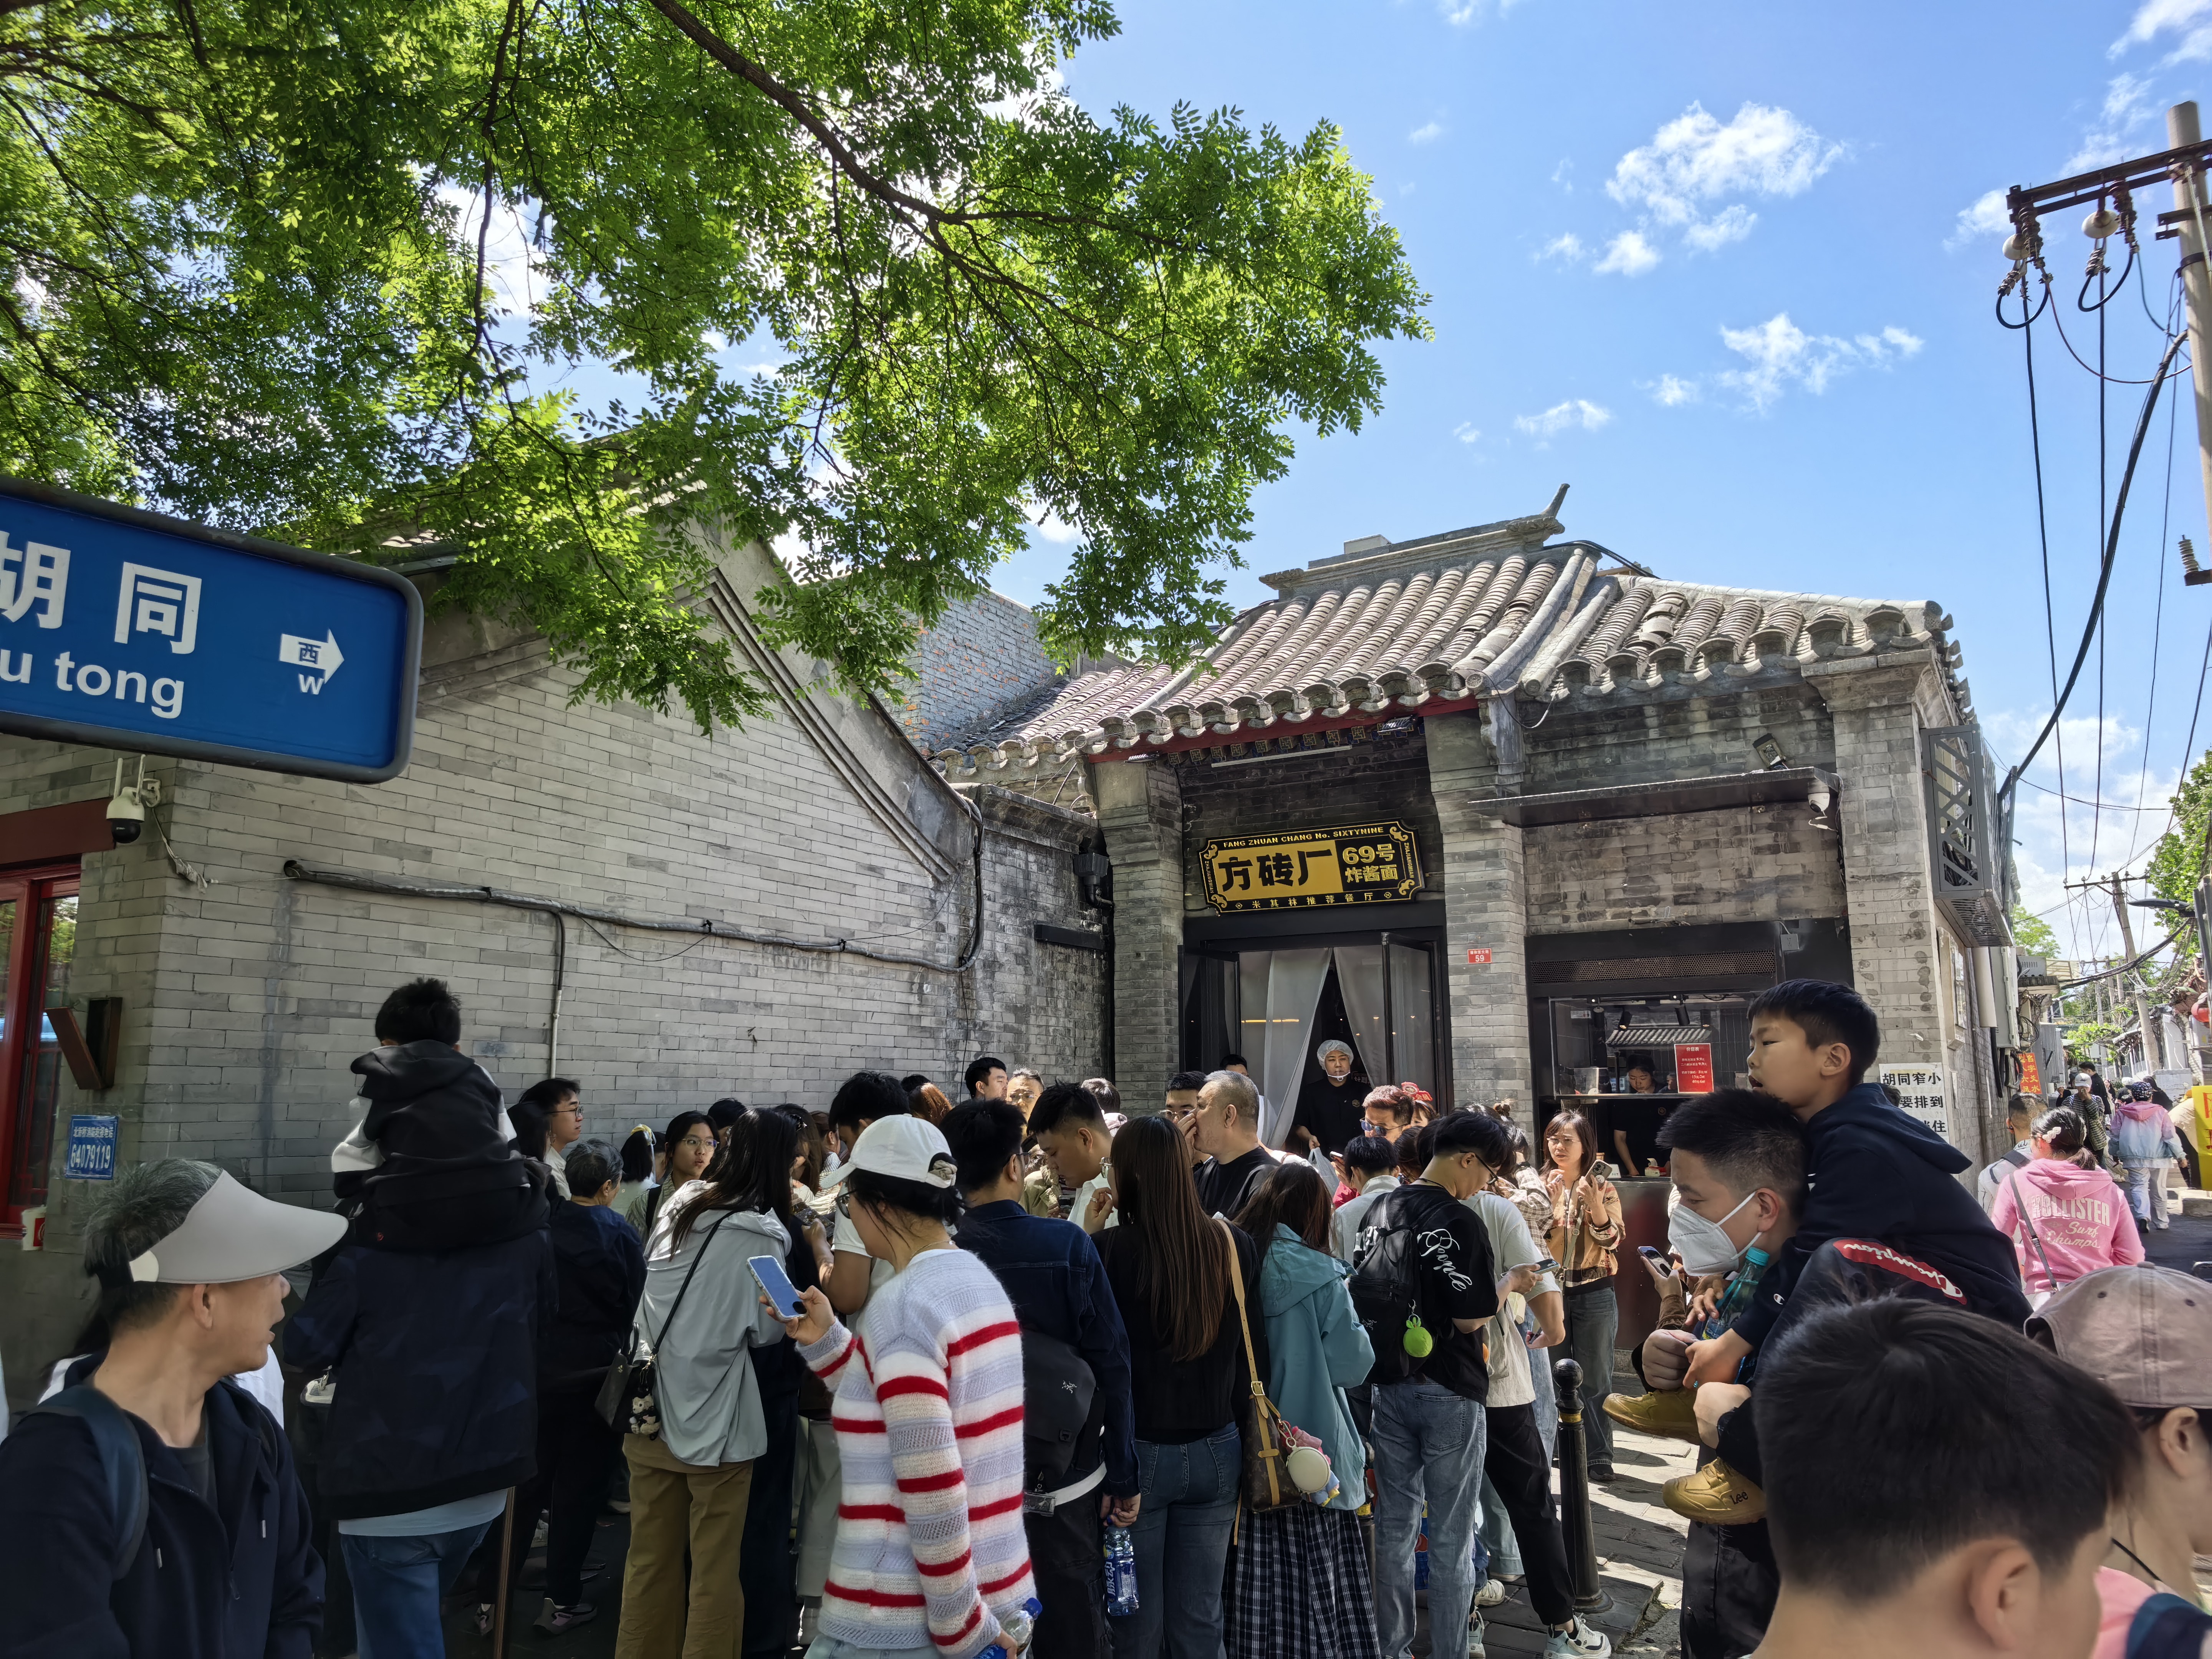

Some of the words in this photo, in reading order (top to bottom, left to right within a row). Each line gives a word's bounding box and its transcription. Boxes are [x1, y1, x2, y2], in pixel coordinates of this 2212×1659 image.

[298, 642, 321, 664] 西
[55, 651, 184, 719] tong
[298, 673, 325, 694] W
[1248, 837, 1278, 846] ZHUAN
[1281, 833, 1312, 842] CHANG
[1333, 827, 1384, 837] SIXTYNINE
[1343, 843, 1395, 864] 69号
[1404, 842, 1414, 878] ZHAJIANGMIAN
[1218, 849, 1333, 892] 方砖厂
[1345, 864, 1398, 883] 炸酱面
[1252, 892, 1373, 909] 米其林推荐餐厅
[1882, 1072, 1941, 1086] 胡同窄小
[70, 1144, 111, 1169] 64079119
[2032, 1194, 2110, 1227] HOLLISTER
[2046, 1230, 2100, 1248] Champs
[2065, 1222, 2100, 1238] Surf
[1843, 1244, 1963, 1298] Champion
[1729, 1492, 1748, 1505] Lee
